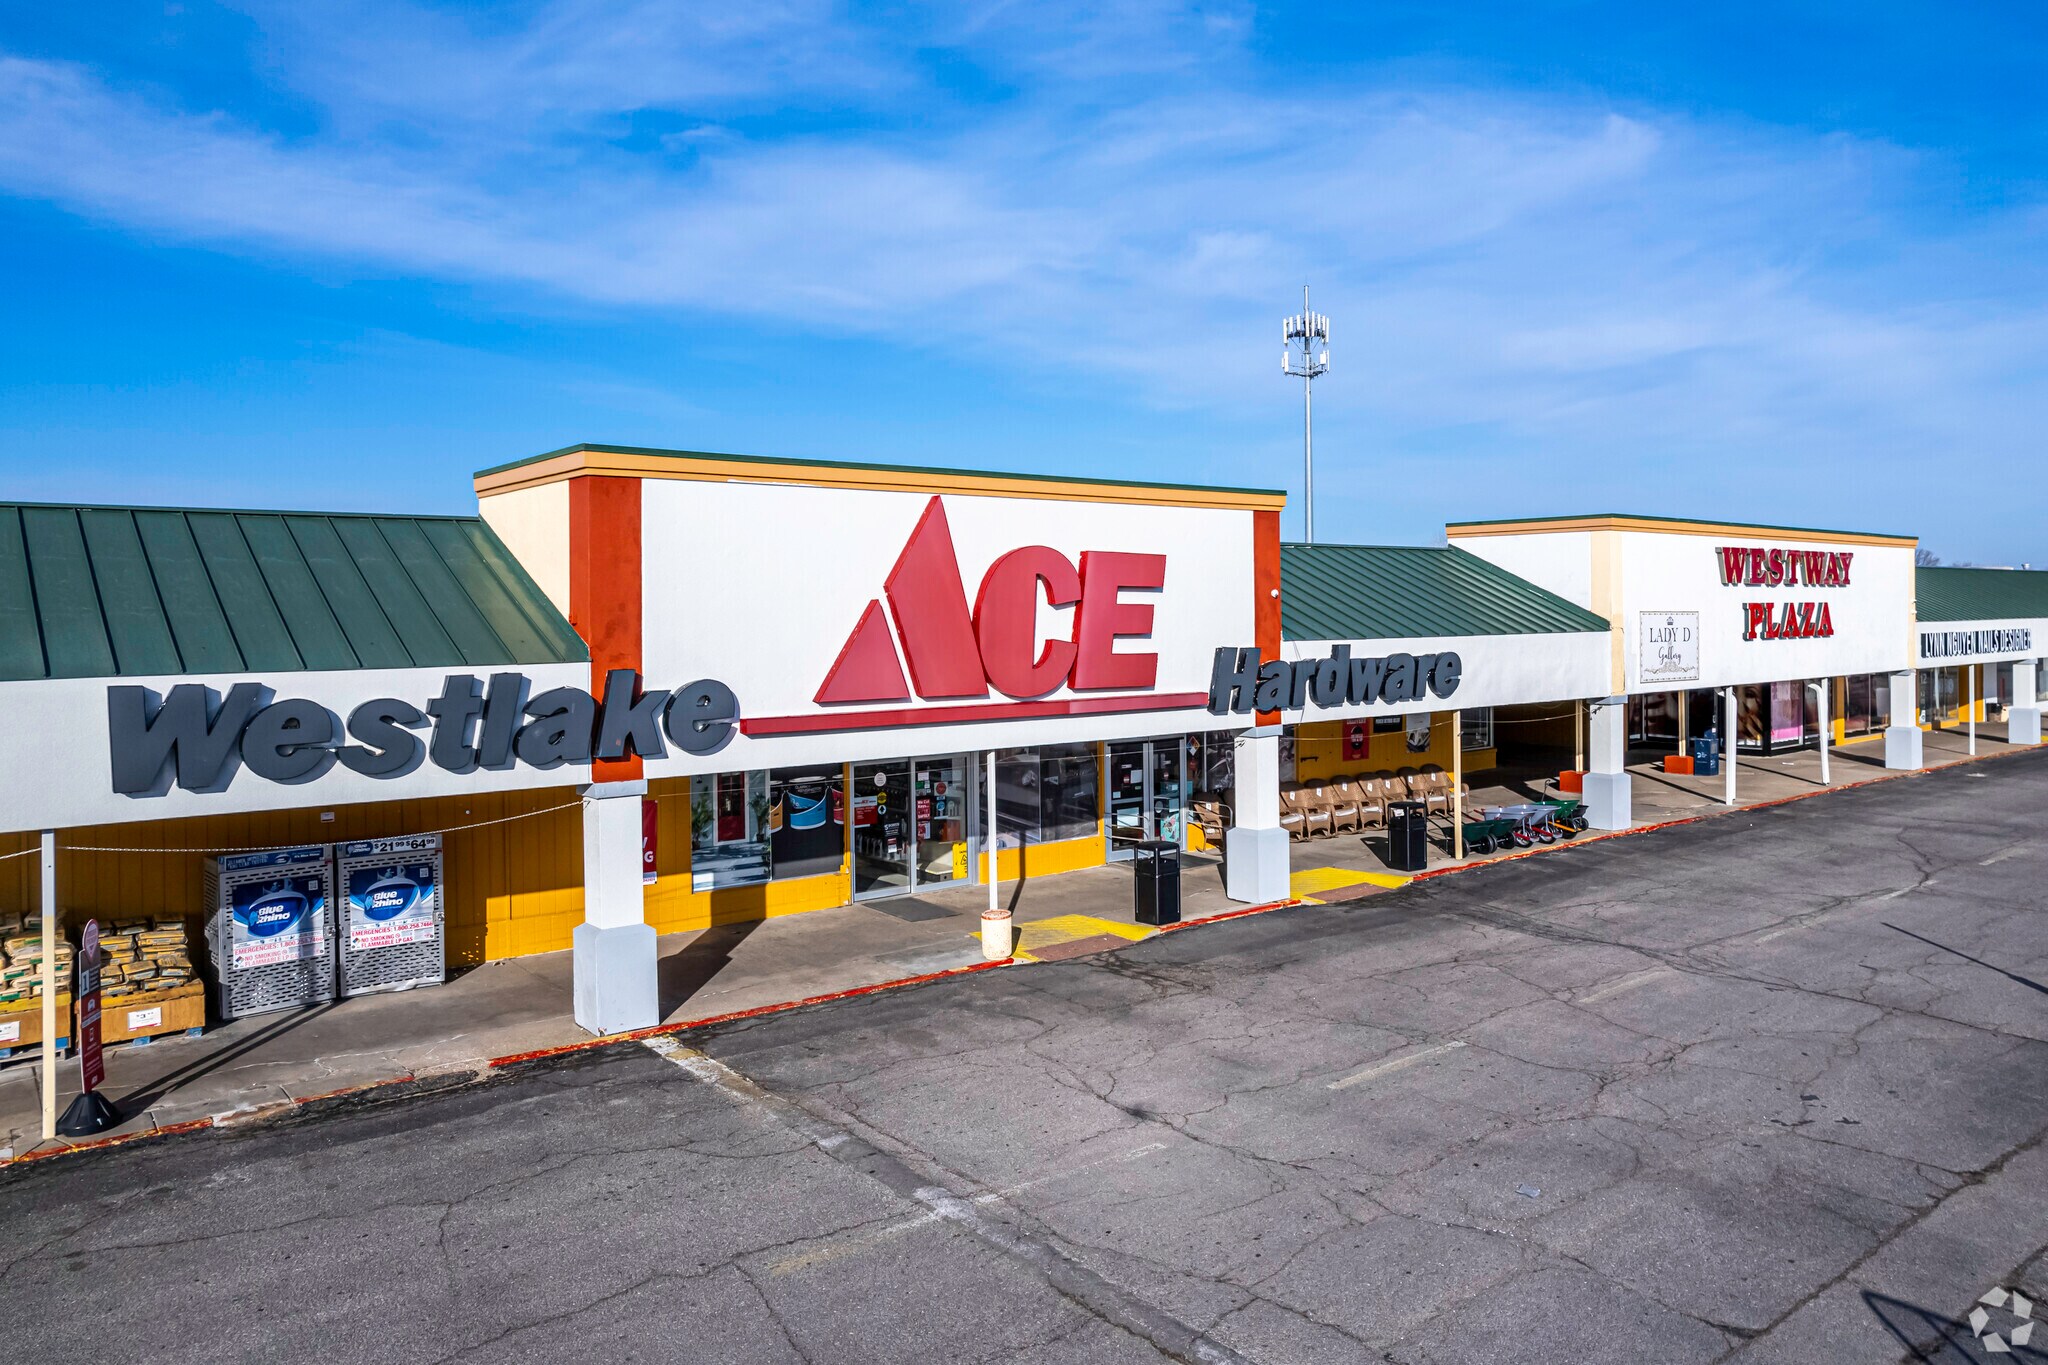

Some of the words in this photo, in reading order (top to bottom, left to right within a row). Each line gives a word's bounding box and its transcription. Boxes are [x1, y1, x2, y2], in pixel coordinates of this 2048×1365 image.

[1715, 546, 1854, 588] WESTWAY
[813, 495, 1167, 704] ACE
[1649, 627, 1679, 643] LADY
[1682, 626, 1691, 642] D
[1742, 602, 1834, 642] PLAZA
[1658, 645, 1681, 665] Gallery
[1921, 632, 1946, 658] LYNN
[1946, 630, 1977, 657] NGUYEN
[1978, 629, 2000, 655] NAILS
[1207, 643, 1462, 716] Hardware
[107, 668, 739, 797] Westlake
[258, 905, 284, 916] Blue
[373, 890, 397, 900] Blue
